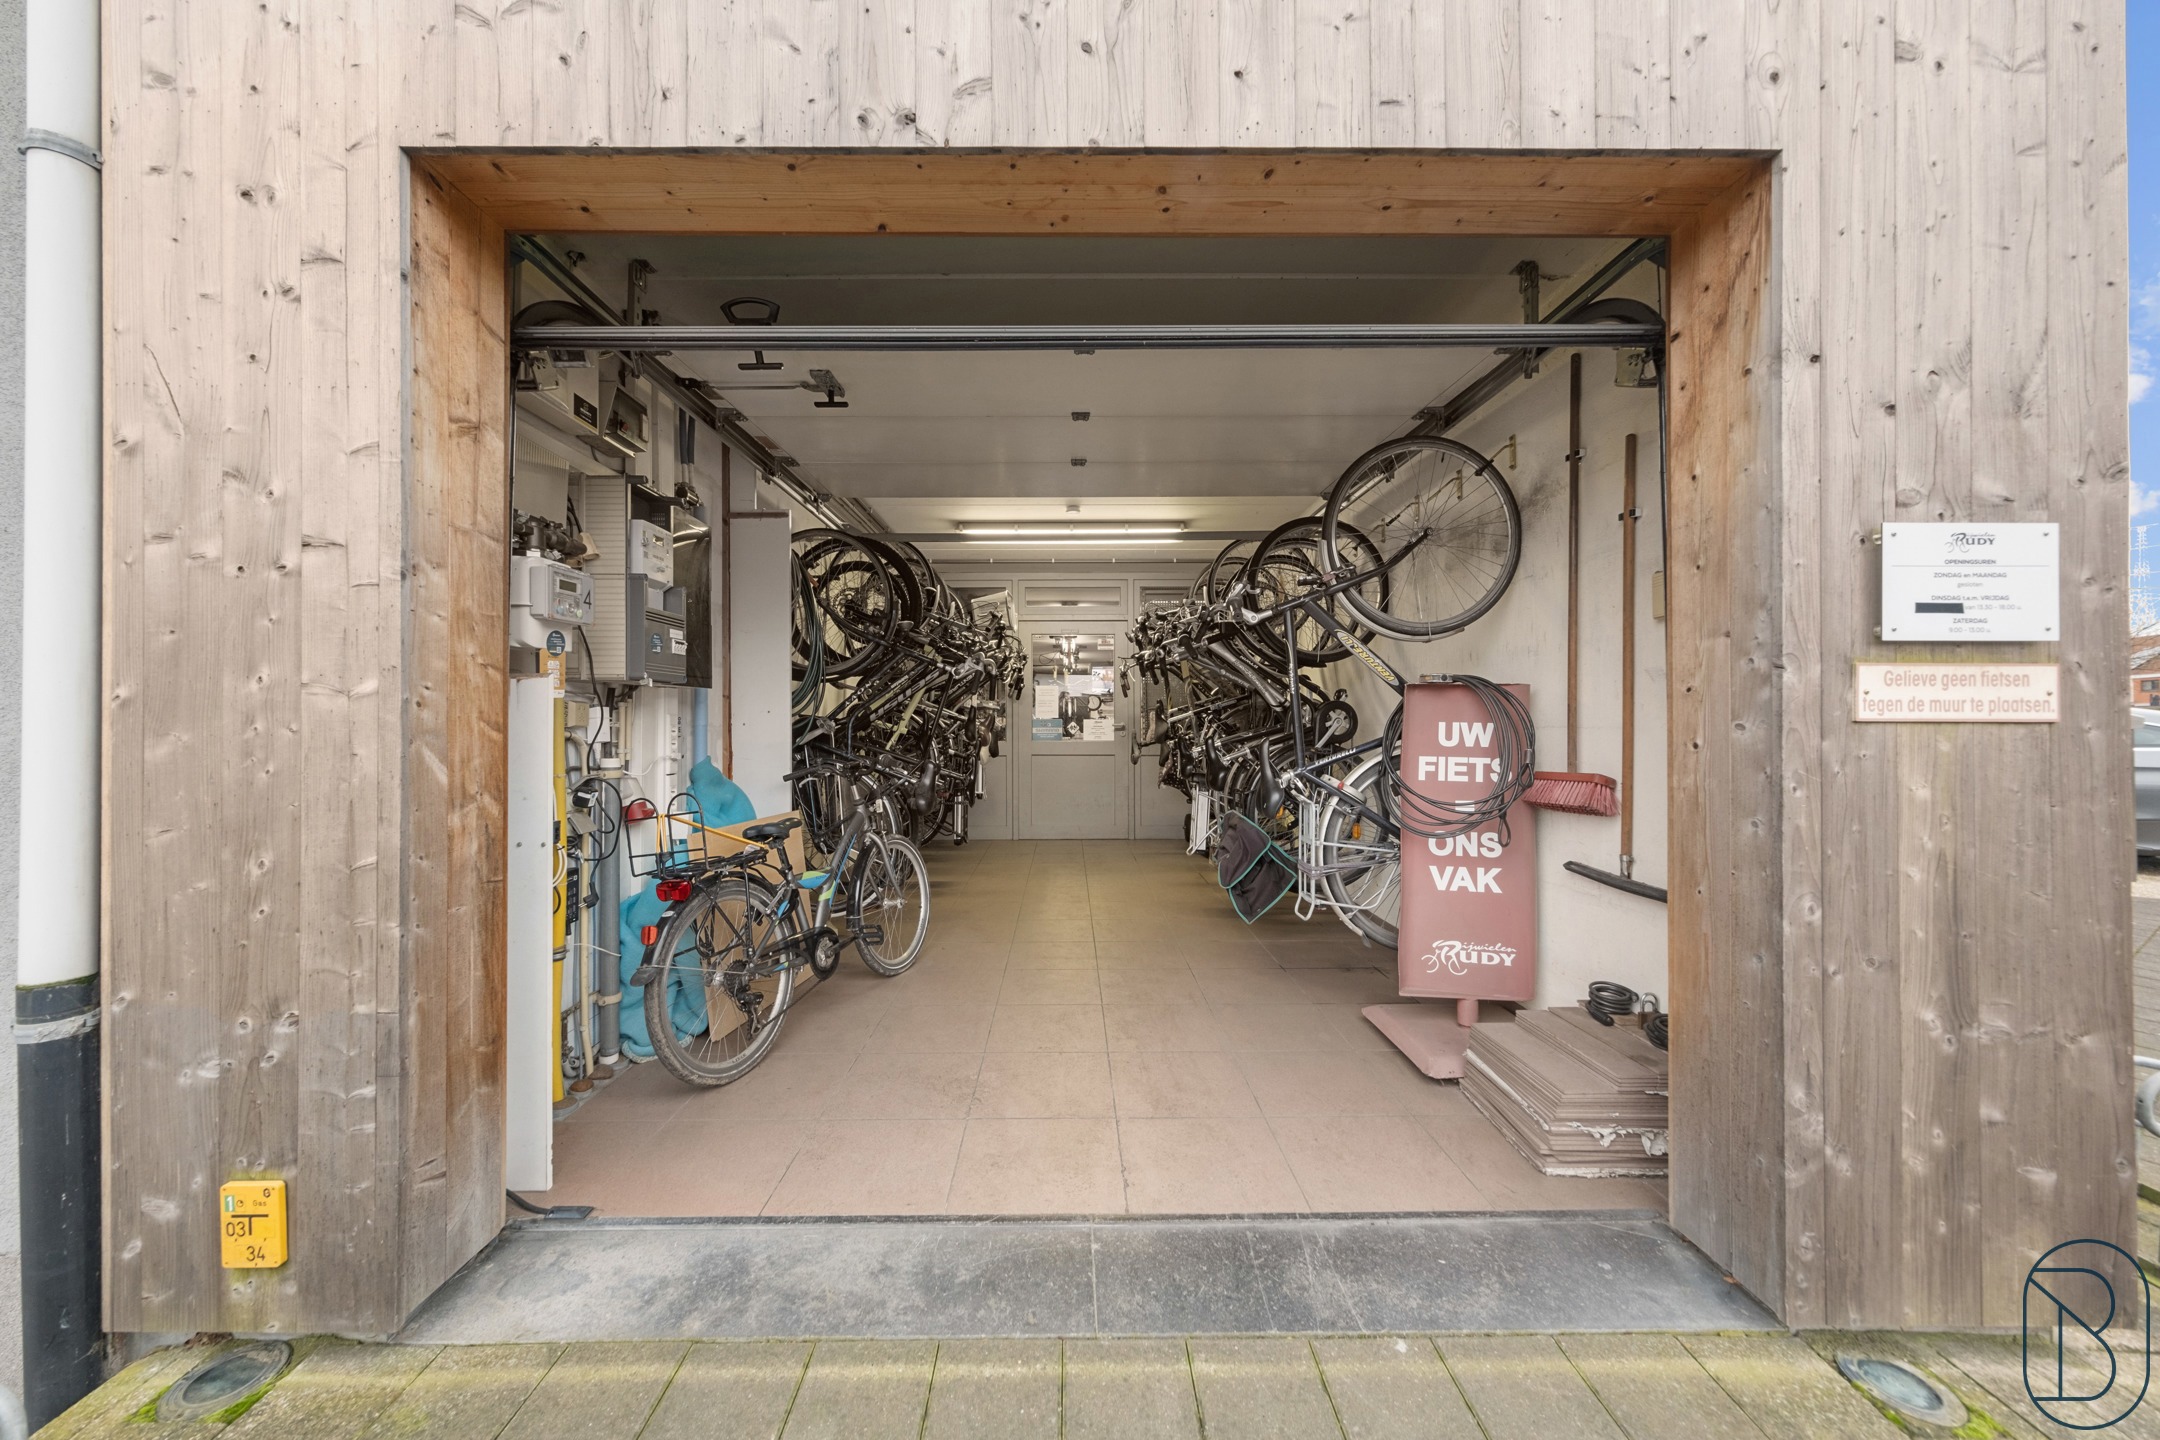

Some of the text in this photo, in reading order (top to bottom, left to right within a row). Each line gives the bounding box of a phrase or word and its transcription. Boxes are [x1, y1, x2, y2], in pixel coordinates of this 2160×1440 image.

[1951, 532, 1995, 547] RUDY
[583, 589, 593, 610] 4
[1884, 670, 2030, 691] Gelieve geen fietsen
[1863, 697, 2055, 716] tegen de muur te plaatsen.
[1438, 722, 1495, 747] UW
[1428, 831, 1503, 858] ONS
[1428, 866, 1503, 893] VAK
[1432, 940, 1516, 970] RUDY
[226, 1195, 233, 1212] 1
